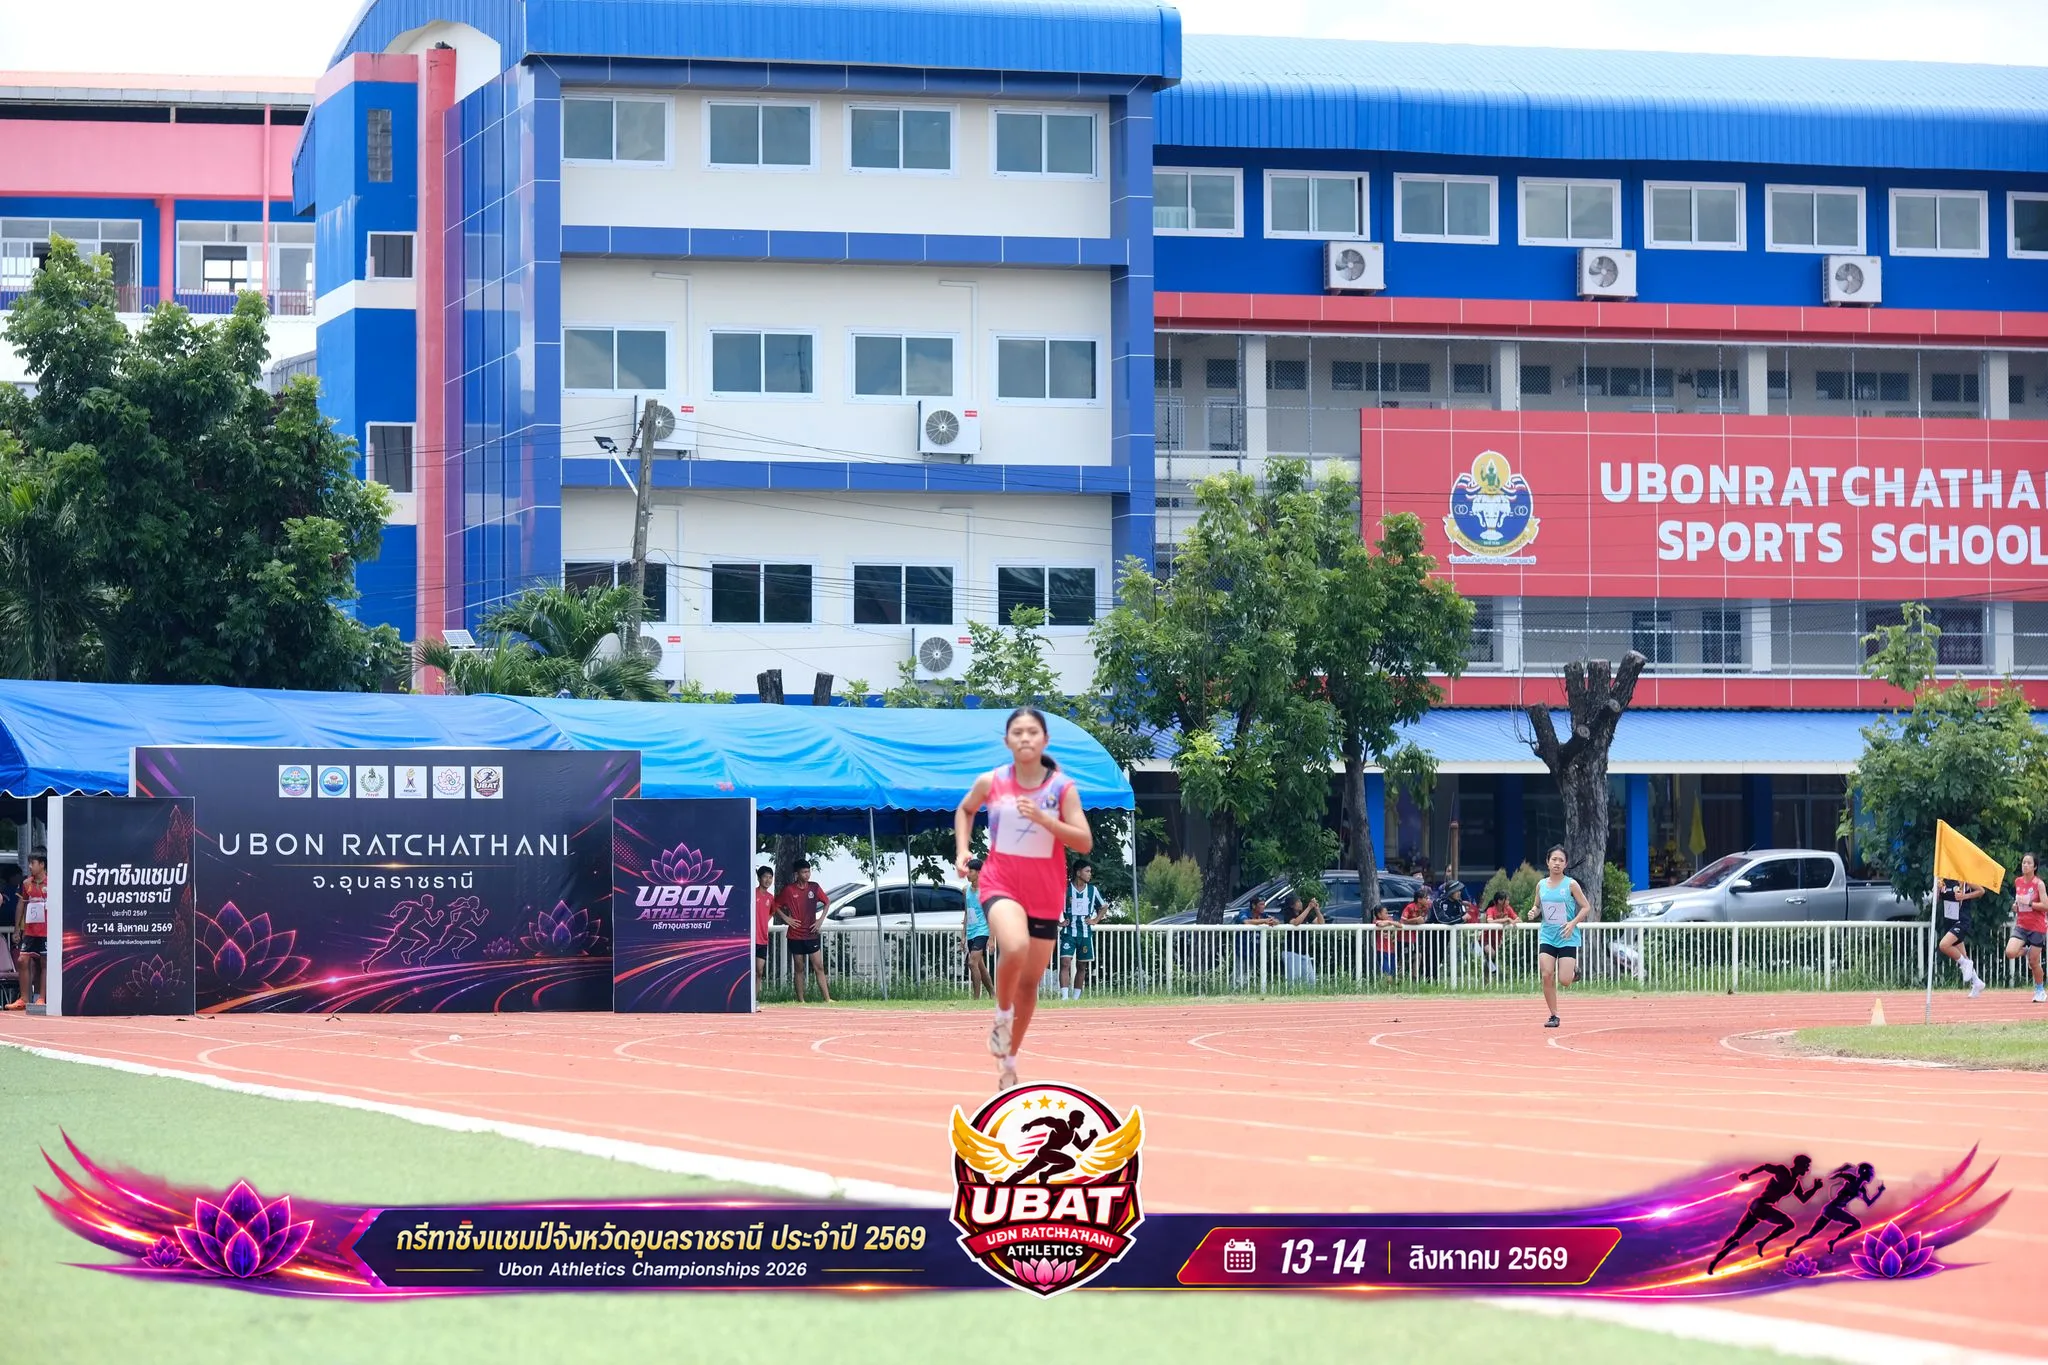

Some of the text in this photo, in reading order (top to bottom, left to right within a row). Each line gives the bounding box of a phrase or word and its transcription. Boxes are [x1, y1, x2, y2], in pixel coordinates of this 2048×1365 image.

[1601, 462, 2048, 509] UBONRATCHATHA
[1657, 520, 2048, 566] SPORTS SCHOOL
[219, 833, 568, 856] UBON RATCHATHANI
[72, 863, 188, 886] กรีฑาชิงแชมป์
[312, 871, 473, 895] จ.อุบลราชธานี
[86, 887, 172, 908] จ.อุบลราชธานี
[635, 885, 734, 906] UBON
[637, 908, 730, 919] ATHLETICS
[1548, 906, 1557, 920] 2
[117, 922, 149, 933] สิงหาคม
[151, 922, 173, 933] 2569
